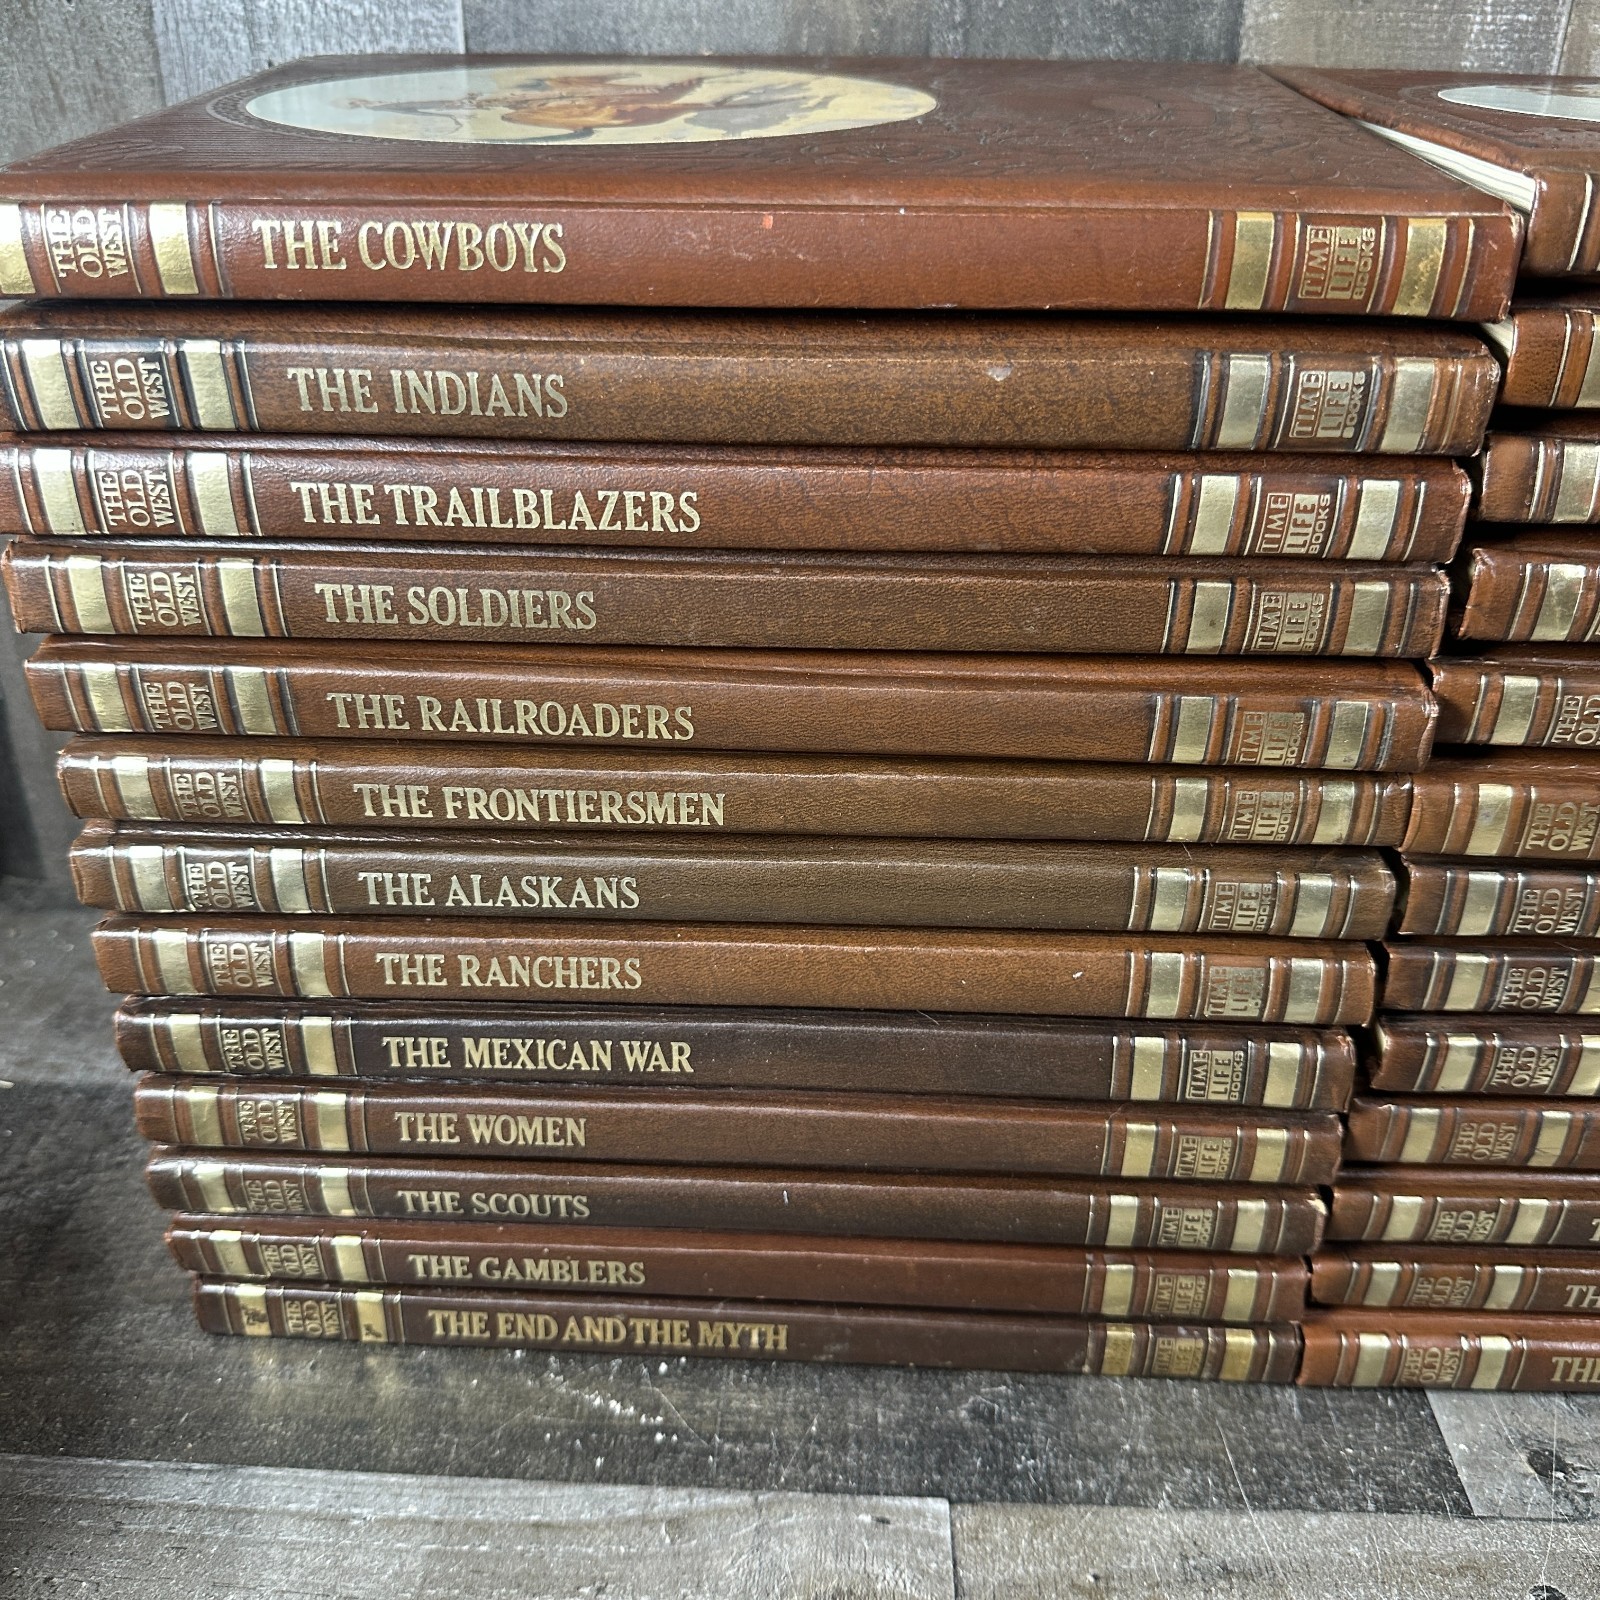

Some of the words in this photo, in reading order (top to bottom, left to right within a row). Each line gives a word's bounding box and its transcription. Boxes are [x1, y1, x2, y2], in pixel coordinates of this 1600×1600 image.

[50, 209, 76, 278] THE
[72, 209, 103, 278] OLD
[101, 209, 129, 277] WEST
[252, 220, 347, 270] THE
[358, 220, 567, 273] COWBOYS
[1300, 226, 1333, 298] TIME
[1327, 229, 1361, 298] LIFE
[1353, 227, 1376, 299] BOOKS
[90, 361, 121, 420] THE
[115, 358, 145, 420] OLD
[138, 357, 170, 419] WEST
[287, 367, 379, 414] THE
[389, 369, 568, 418] INDIANS
[1293, 372, 1324, 437] TIME
[1318, 375, 1351, 436] LIFE
[1343, 371, 1366, 438] BOOKS
[98, 470, 128, 527] THE
[120, 469, 150, 528] OLD
[145, 469, 175, 527] WEST
[290, 482, 380, 525] THE
[383, 483, 701, 533] TRAILBLAZERS
[1258, 494, 1291, 552] TIME
[1284, 498, 1318, 551] LIFE
[1309, 494, 1330, 554] BOOKS
[128, 572, 156, 626] THE
[151, 571, 178, 627] OLD
[173, 572, 202, 627] WEST
[314, 583, 398, 625] THE
[407, 585, 597, 630] SOLDIERS
[1254, 593, 1285, 650] TIME
[1279, 596, 1310, 649] LIFE
[1302, 593, 1324, 651] BOOKS
[143, 682, 172, 730] THE
[166, 681, 195, 731] OLD
[188, 683, 218, 730] WEST
[326, 692, 410, 730] THE
[416, 695, 695, 741] RAILROADERS
[1551, 696, 1583, 743] THE
[1238, 712, 1265, 764] TIME
[1261, 714, 1291, 763] LIFE
[1284, 713, 1304, 766] BOOKS
[172, 772, 202, 818] THE
[196, 771, 222, 819] OLD
[217, 772, 246, 818] WEST
[353, 783, 433, 818] THE
[441, 786, 726, 827] FRONTIERSMEN
[1230, 792, 1257, 840] TIME
[1253, 795, 1282, 840] LIFE
[1276, 792, 1294, 841] BOOKS
[1525, 803, 1555, 849] THE
[1548, 801, 1577, 851] OLD
[1569, 802, 1600, 851] WEST
[186, 862, 205, 908] THE
[206, 861, 232, 909] OLD
[227, 862, 255, 908] WEST
[358, 872, 436, 907] THE
[445, 874, 640, 909] ALASKANS
[1209, 883, 1237, 929] TIME
[1234, 886, 1260, 929] LIFE
[1255, 884, 1272, 931] BOOKS
[1514, 890, 1541, 933] THE
[1535, 888, 1560, 934] OLD
[1555, 888, 1584, 934] WEST
[208, 943, 229, 987] THE
[228, 942, 253, 987] OLD
[250, 942, 275, 987] WEST
[376, 952, 448, 987] THE
[457, 954, 642, 990] RANCHERS
[1499, 967, 1526, 1008] THE
[1540, 967, 1569, 1009] WEST
[1207, 967, 1229, 1015] TIME
[1228, 970, 1252, 1014] LIFE
[1520, 967, 1547, 1010] OLD
[220, 1029, 245, 1068] THE
[243, 1027, 267, 1069] OLD
[260, 1027, 286, 1069] WEST
[382, 1036, 452, 1068] THE
[462, 1037, 612, 1072] MEXICAN
[619, 1040, 695, 1073] WAR
[1491, 1048, 1517, 1086] THE
[1511, 1047, 1538, 1087] OLD
[1529, 1048, 1558, 1087] WEST
[1188, 1051, 1210, 1098] TIME
[1209, 1054, 1232, 1098] LIFE
[258, 1100, 278, 1143] OLD
[394, 1111, 460, 1143] THE
[466, 1113, 587, 1148] WOMEN
[1451, 1123, 1476, 1159] THE
[1471, 1123, 1496, 1160] OLD
[264, 1179, 287, 1213] OLD
[397, 1189, 465, 1215] THE
[472, 1191, 590, 1219] SCOUTS
[281, 1243, 302, 1275] OLD
[407, 1254, 473, 1279] THE
[478, 1256, 646, 1286] GAMBLERS
[303, 1300, 322, 1336] OLD
[1563, 1284, 1600, 1308] TH
[427, 1309, 491, 1339] THE
[496, 1312, 557, 1344] END
[562, 1314, 627, 1346] AND
[629, 1317, 692, 1348] THE
[698, 1320, 789, 1351] MYTH
